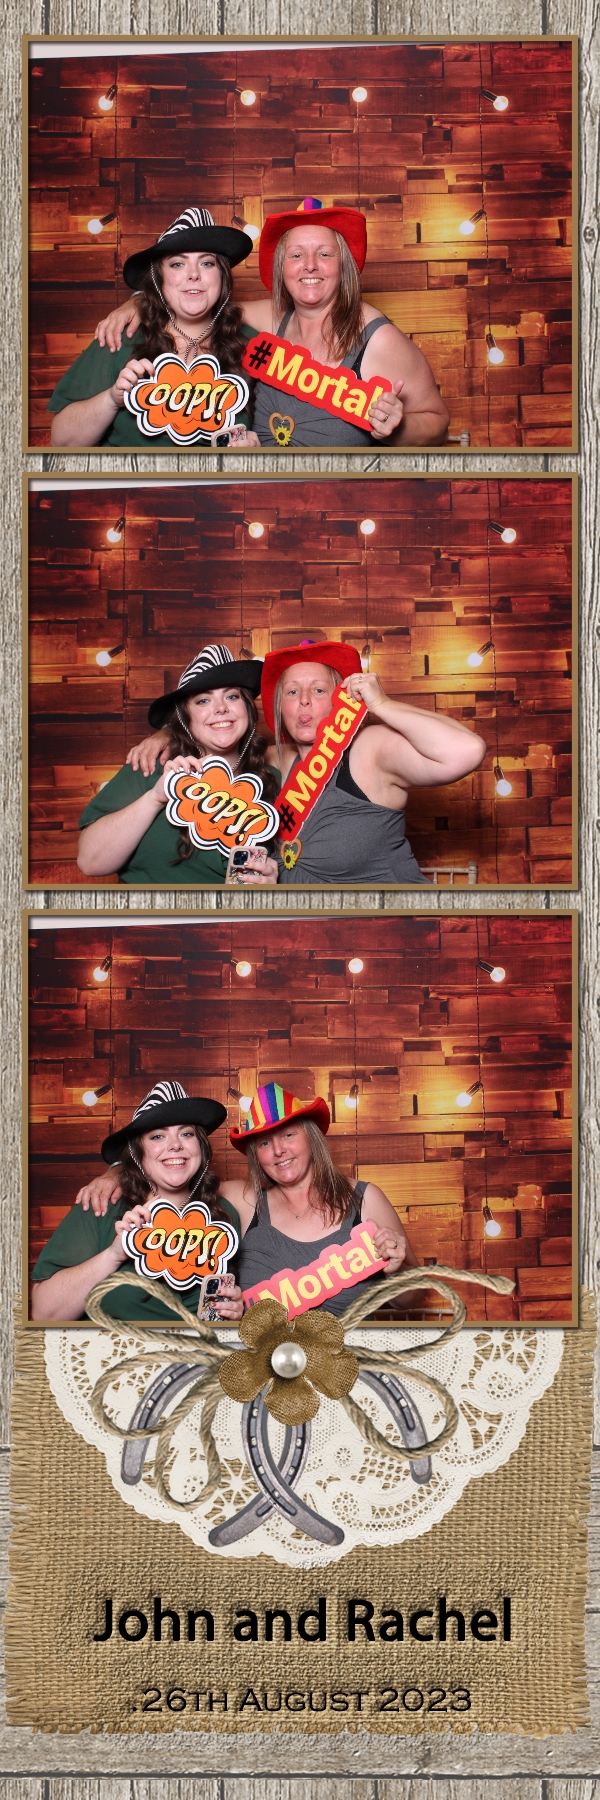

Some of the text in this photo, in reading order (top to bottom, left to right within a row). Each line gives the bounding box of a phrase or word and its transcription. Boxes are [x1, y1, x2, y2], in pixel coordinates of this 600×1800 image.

[145, 382, 238, 425] OOPS!
[182, 782, 271, 845] OOPS!
[142, 1228, 228, 1271] OOPS!
[247, 1230, 382, 1312] Mortal
